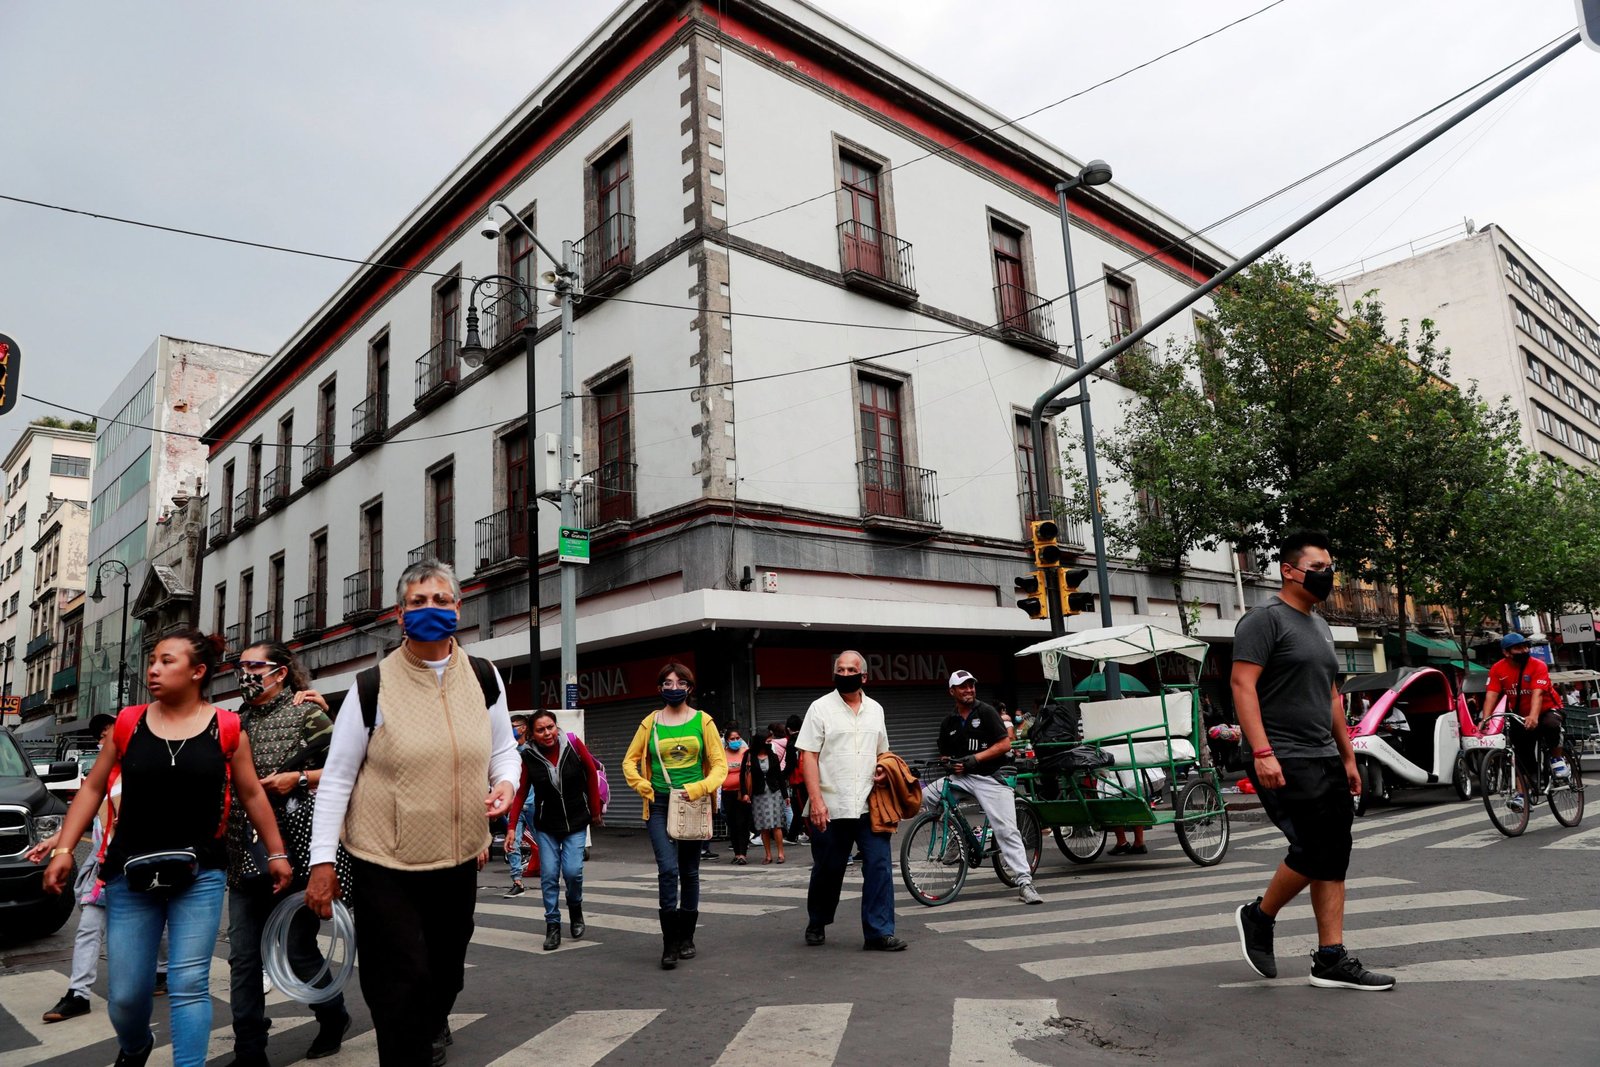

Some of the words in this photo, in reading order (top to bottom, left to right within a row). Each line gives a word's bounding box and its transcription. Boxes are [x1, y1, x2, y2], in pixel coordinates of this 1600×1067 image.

[830, 653, 949, 682] RISINA
[1160, 655, 1219, 677] PARNA
[540, 667, 629, 706] PASINA
[1352, 741, 1368, 749] MX
[1466, 739, 1496, 748] CDMX
